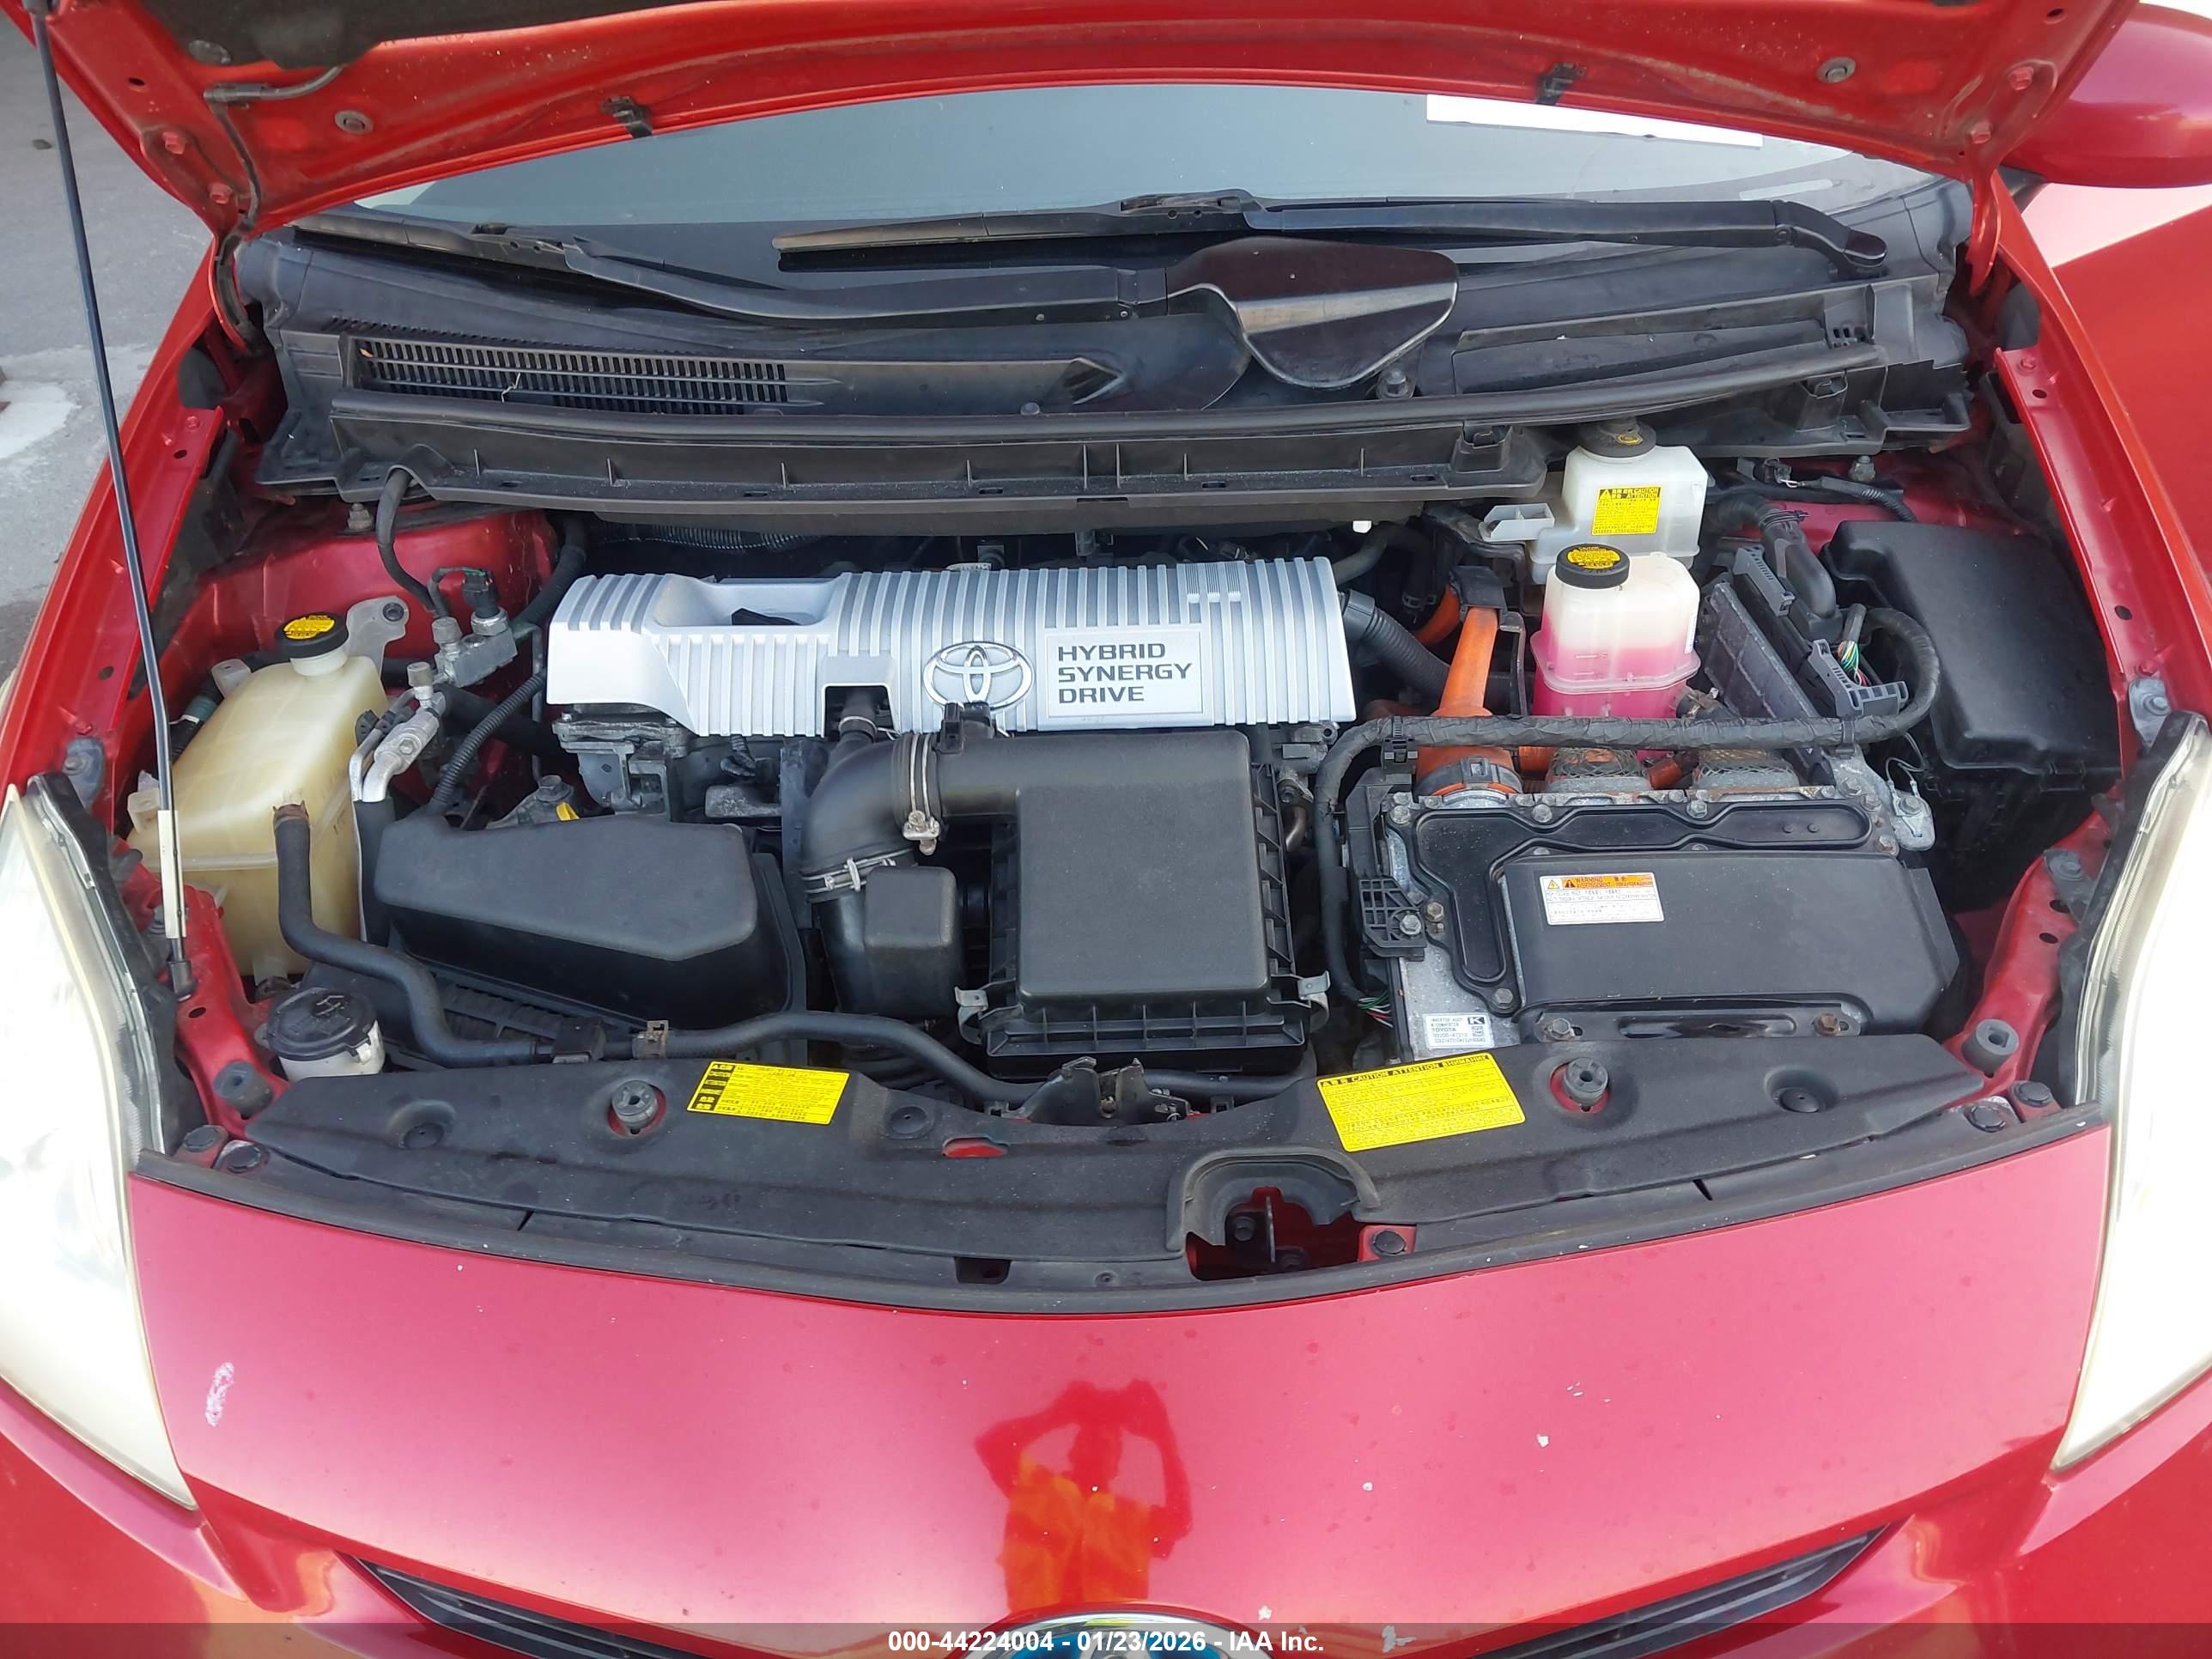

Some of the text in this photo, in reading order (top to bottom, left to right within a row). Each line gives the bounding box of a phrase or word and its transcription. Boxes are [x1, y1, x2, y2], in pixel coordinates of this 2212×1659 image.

[1058, 643, 1165, 661] HYBRID
[1058, 663, 1192, 683] SYNERGY
[1058, 686, 1145, 703] DRIVE
[1351, 1072, 1389, 1082] CAUTION
[1392, 1063, 1440, 1075] ATTENTION
